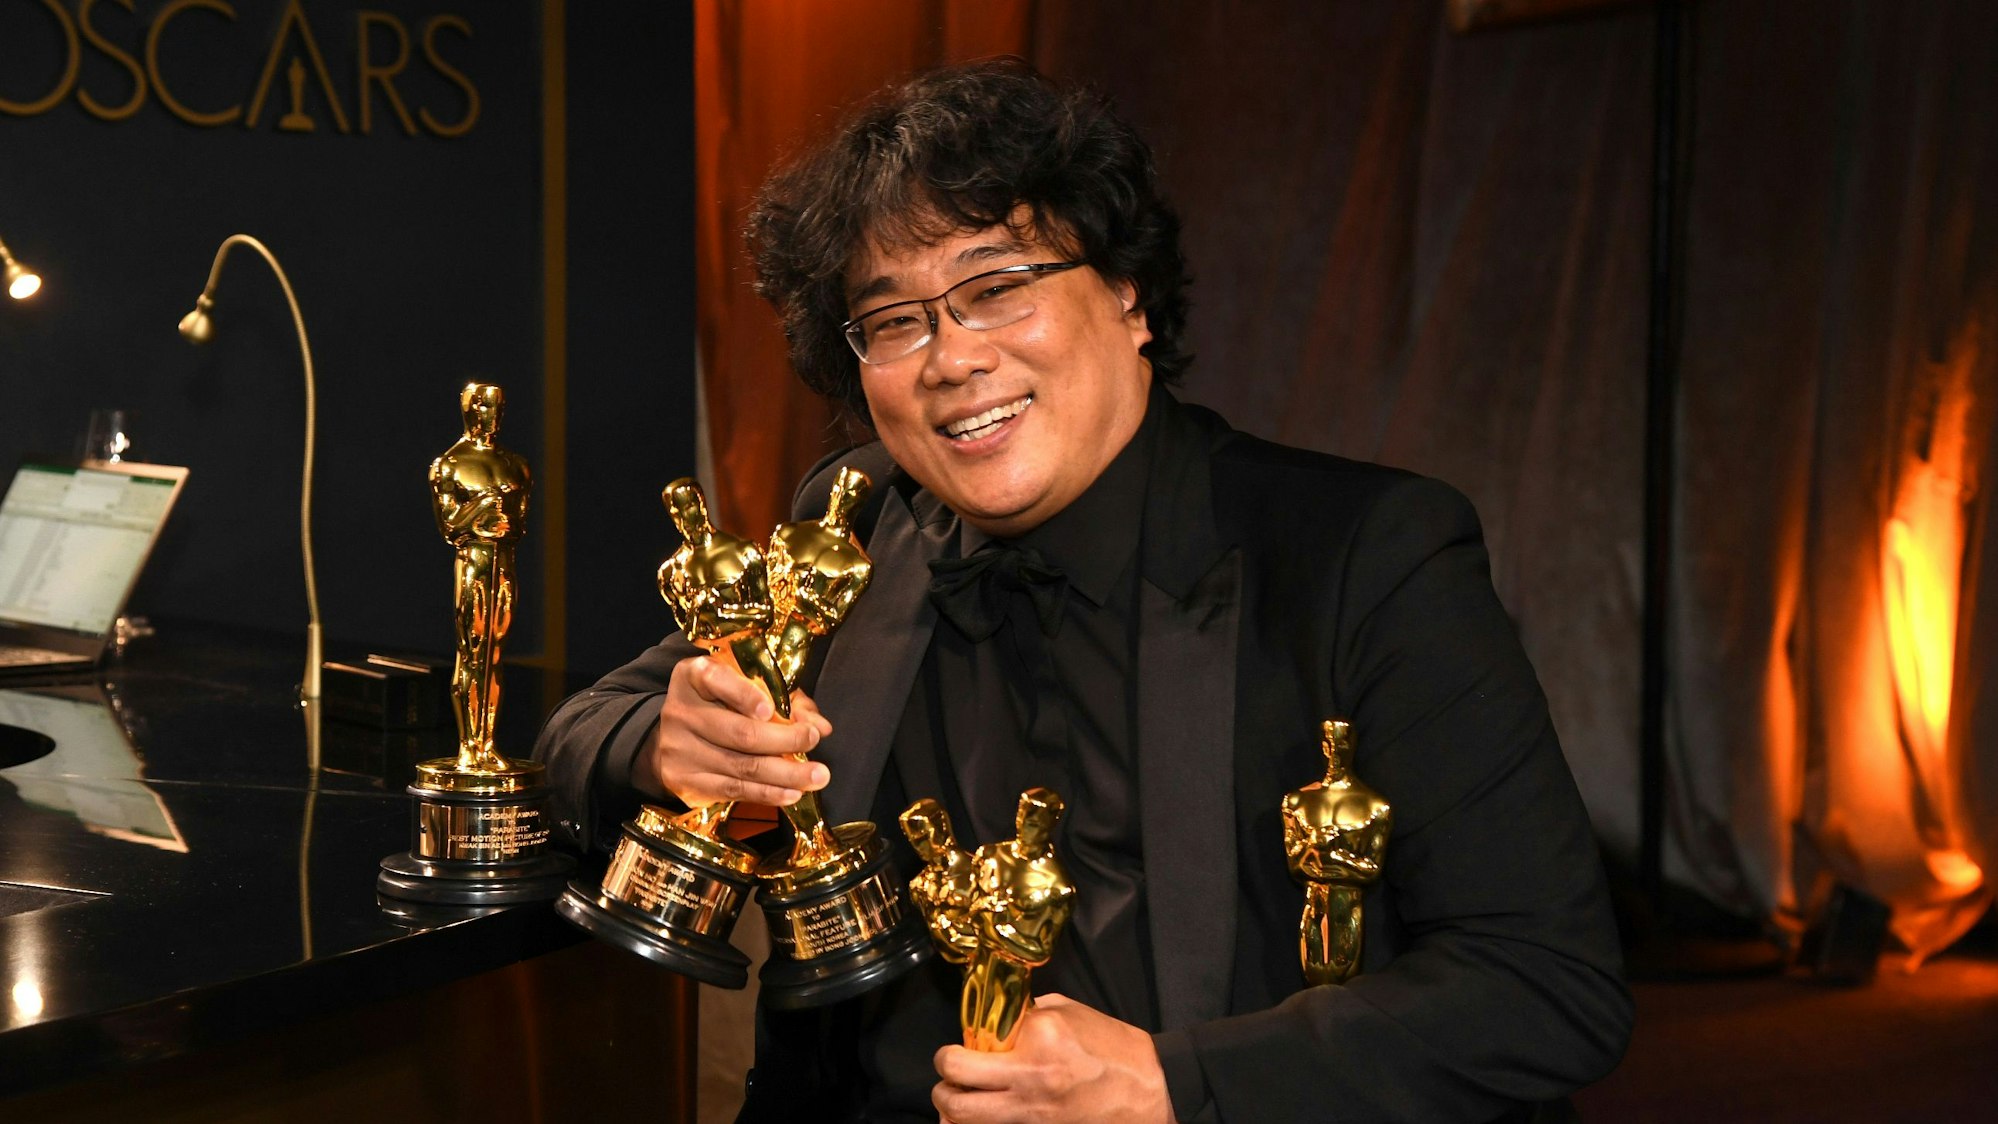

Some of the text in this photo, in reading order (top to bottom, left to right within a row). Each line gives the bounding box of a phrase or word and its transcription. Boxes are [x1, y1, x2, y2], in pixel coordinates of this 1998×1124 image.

[0, 0, 480, 137] OSCARS
[471, 835, 503, 843] MOTION
[685, 892, 699, 901] JIN
[785, 896, 847, 920] AADEMY AWARD
[820, 918, 857, 937] FEATURE
[827, 931, 849, 944] KOREA
[825, 942, 844, 952] BONG
